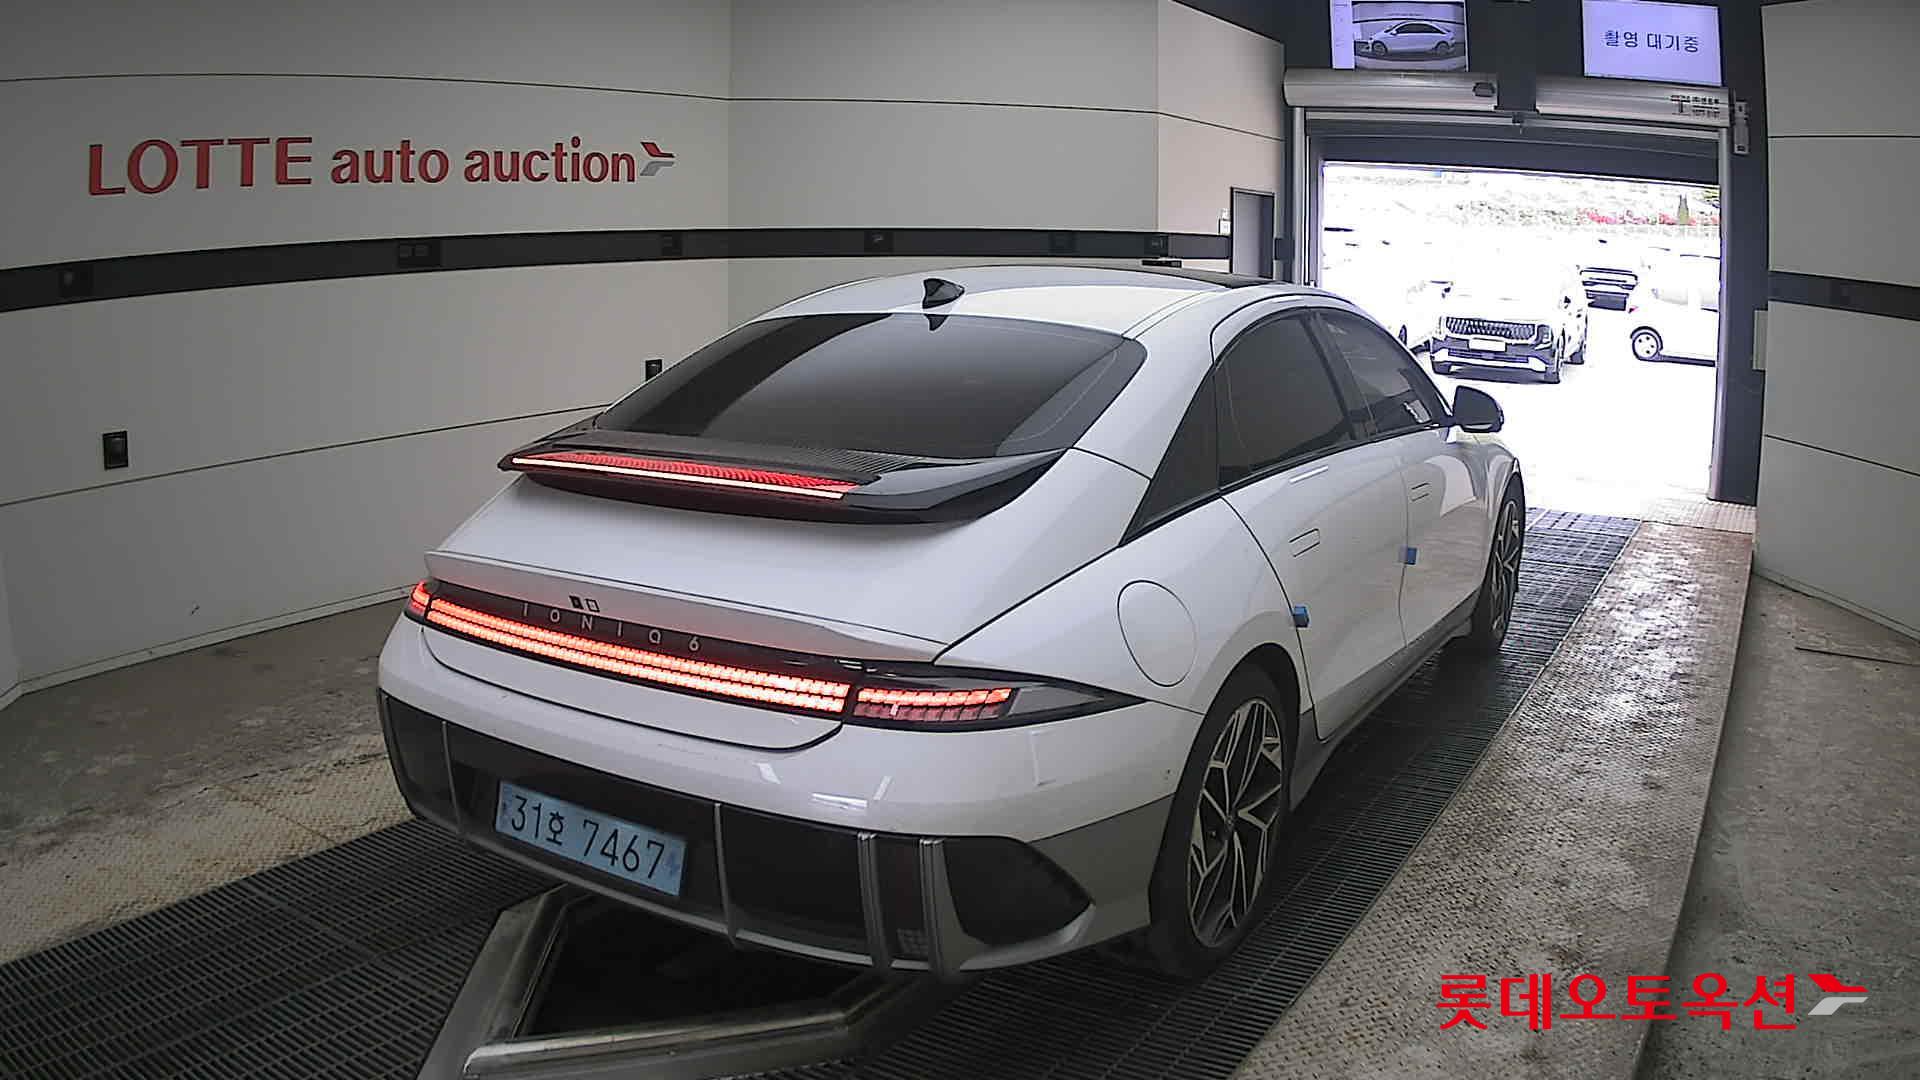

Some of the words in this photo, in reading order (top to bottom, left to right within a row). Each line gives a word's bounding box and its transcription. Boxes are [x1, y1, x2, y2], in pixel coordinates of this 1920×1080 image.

[1647, 33, 1698, 53] 대기중
[89, 136, 313, 196] LOTTE
[330, 139, 449, 184] auto
[464, 135, 636, 183] auction
[511, 795, 566, 847] 31호
[583, 819, 666, 880] 7467
